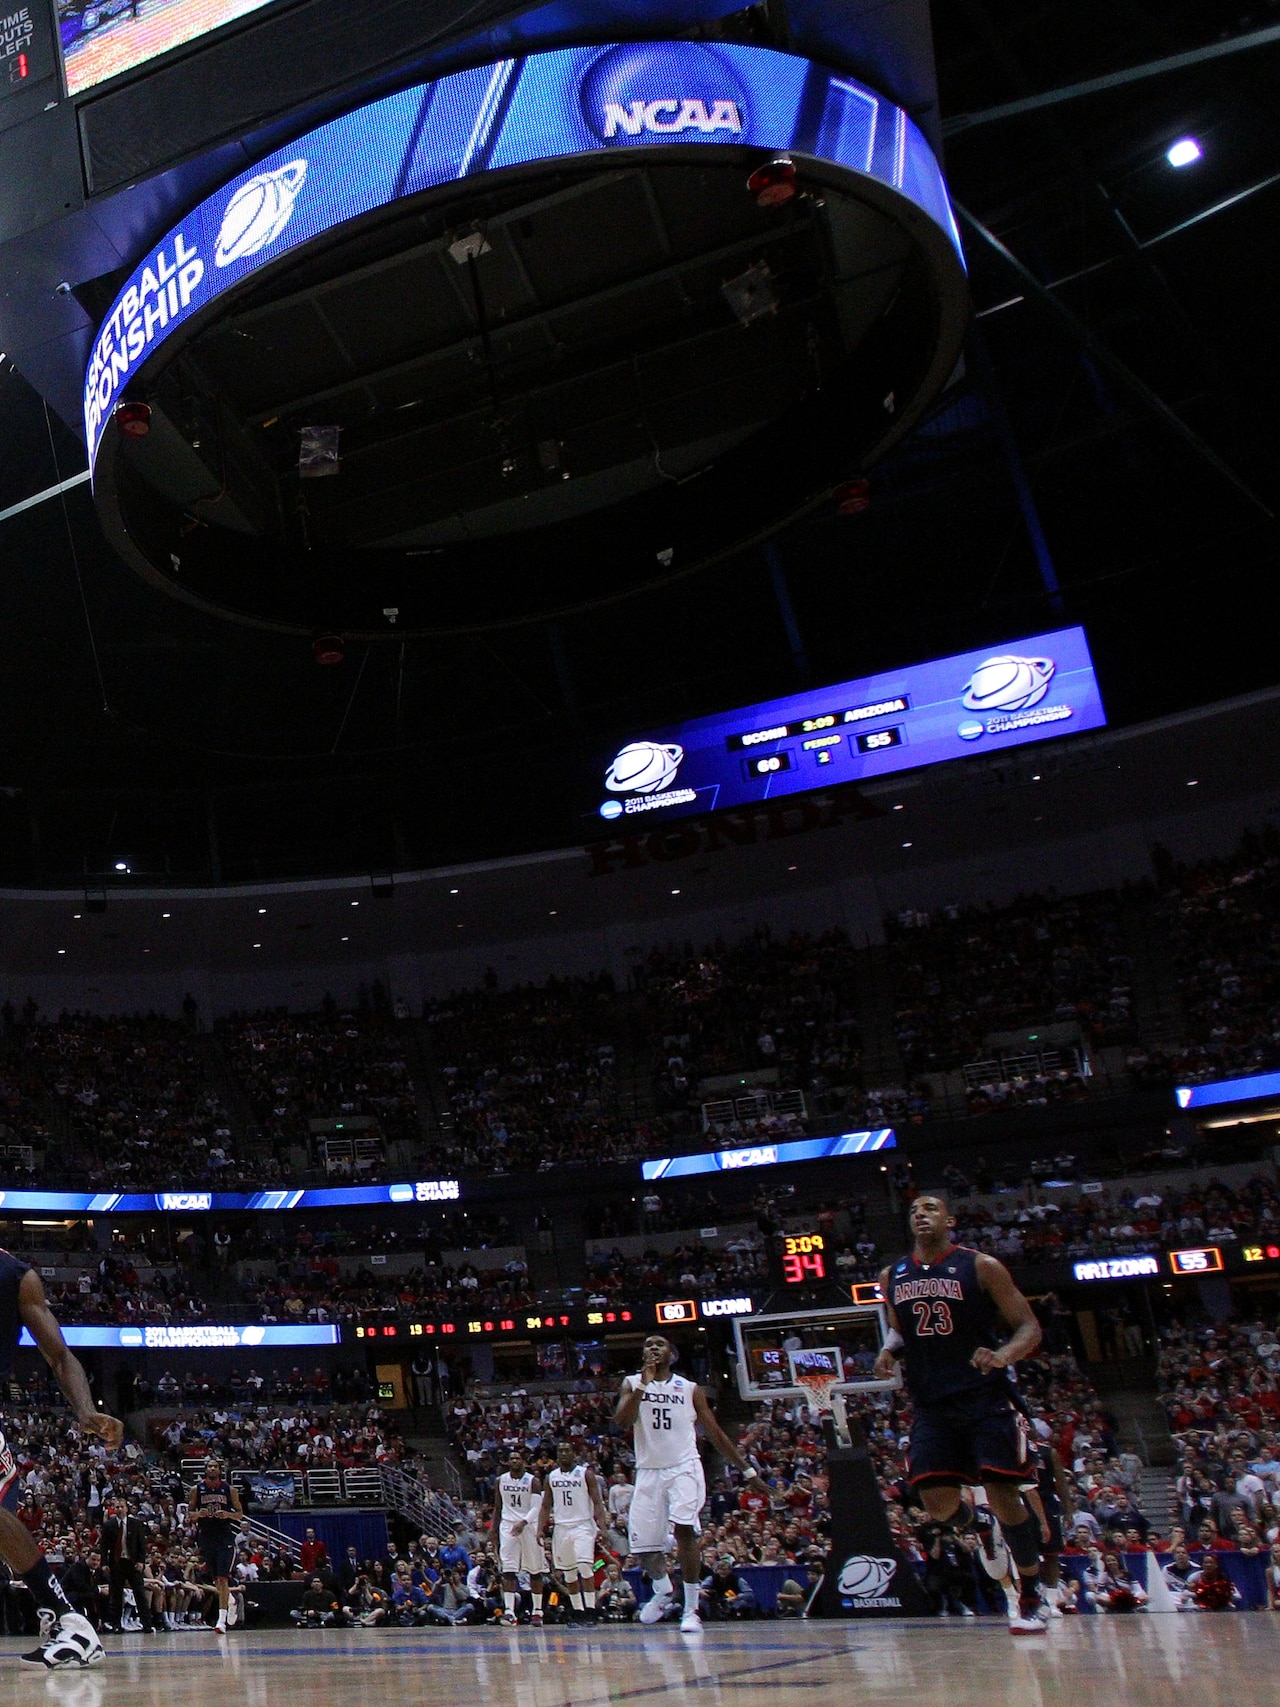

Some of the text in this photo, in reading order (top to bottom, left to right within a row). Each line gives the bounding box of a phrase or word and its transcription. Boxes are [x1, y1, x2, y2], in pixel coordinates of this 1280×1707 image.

[604, 99, 742, 138] NCAA
[742, 699, 907, 746] UCONN 3:09 ARIZONA
[986, 716, 1009, 726] 2011
[987, 709, 1073, 734] CHAMPIONSHIP
[803, 735, 842, 751] PERIOD
[866, 732, 893, 748] 55
[757, 751, 830, 773] 60 2
[624, 798, 644, 808] 2011
[722, 1148, 776, 1169] NCAA
[163, 1195, 209, 1210] NCAA
[785, 1235, 825, 1254] 3:09
[1179, 1252, 1209, 1270] 55
[1243, 1248, 1265, 1261] 12
[783, 1253, 825, 1283] 34
[1075, 1257, 1158, 1280] ARIZONA
[894, 1278, 964, 1305] ARIZONA
[664, 1298, 752, 1320] 60 UCONN
[468, 1321, 482, 1333] 15
[912, 1301, 954, 1336] 23
[145, 1335, 240, 1347] CHAMPIONSHIP
[641, 1392, 685, 1405] UCONN
[652, 1408, 672, 1430] 35
[551, 1480, 581, 1488] UCONN
[510, 1494, 521, 1507] 34
[562, 1490, 573, 1506] 15
[853, 1596, 902, 1608] BASKETBALL
